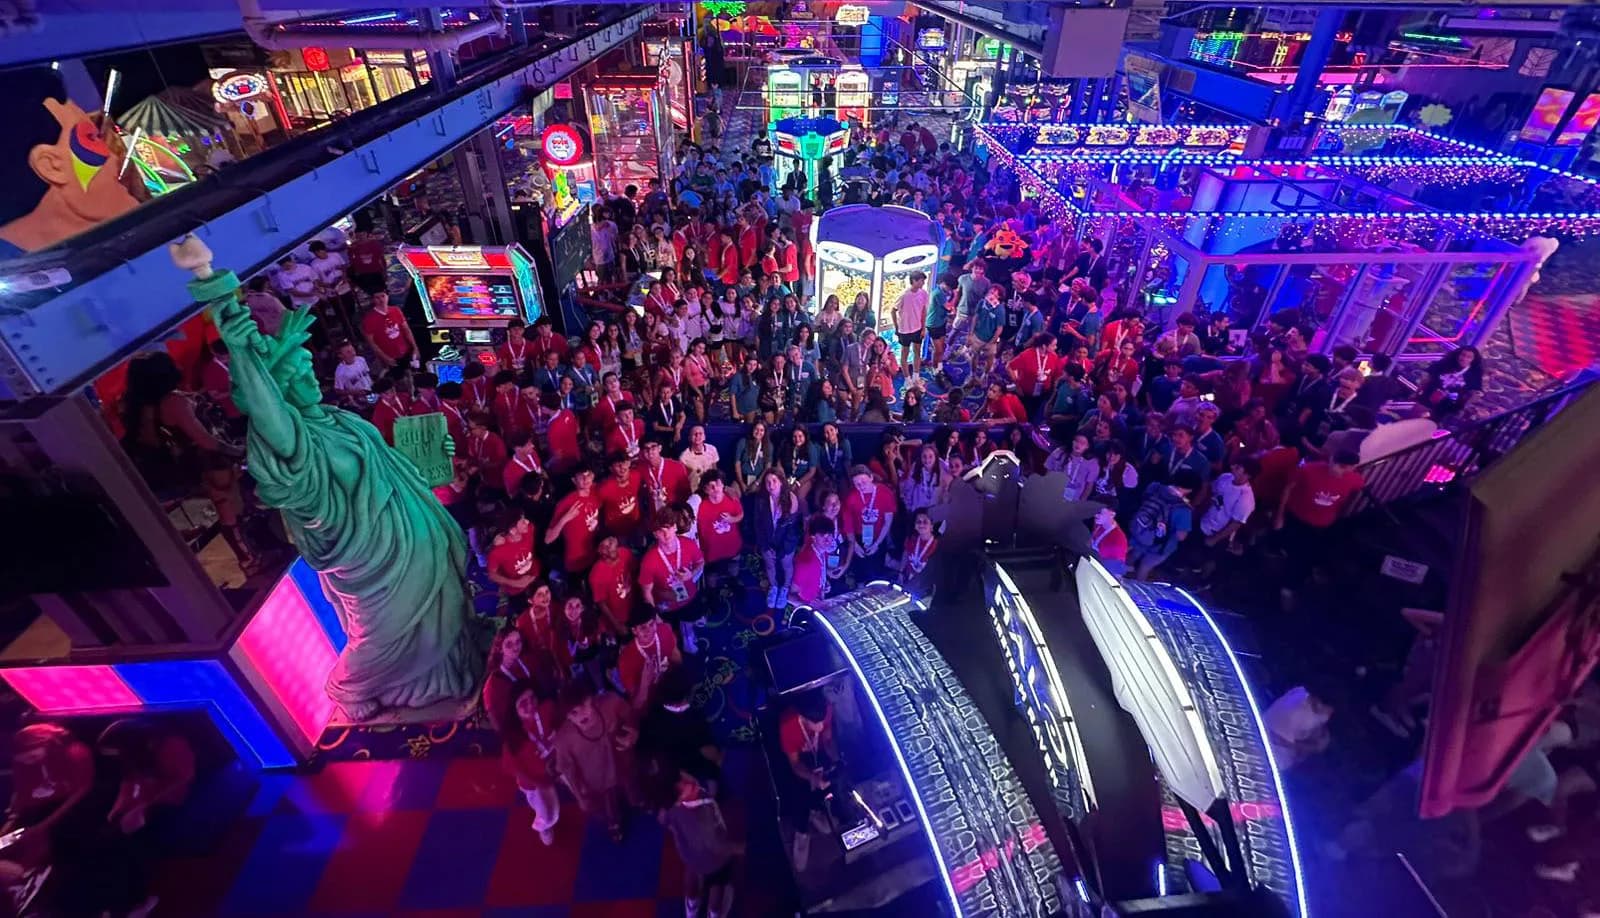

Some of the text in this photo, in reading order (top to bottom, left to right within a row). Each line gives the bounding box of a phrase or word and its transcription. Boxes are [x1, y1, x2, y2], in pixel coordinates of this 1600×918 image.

[401, 425, 436, 446] JULY
[413, 441, 432, 458] IV
[995, 584, 1069, 770] HALO
[1026, 707, 1059, 788] RAVEN
